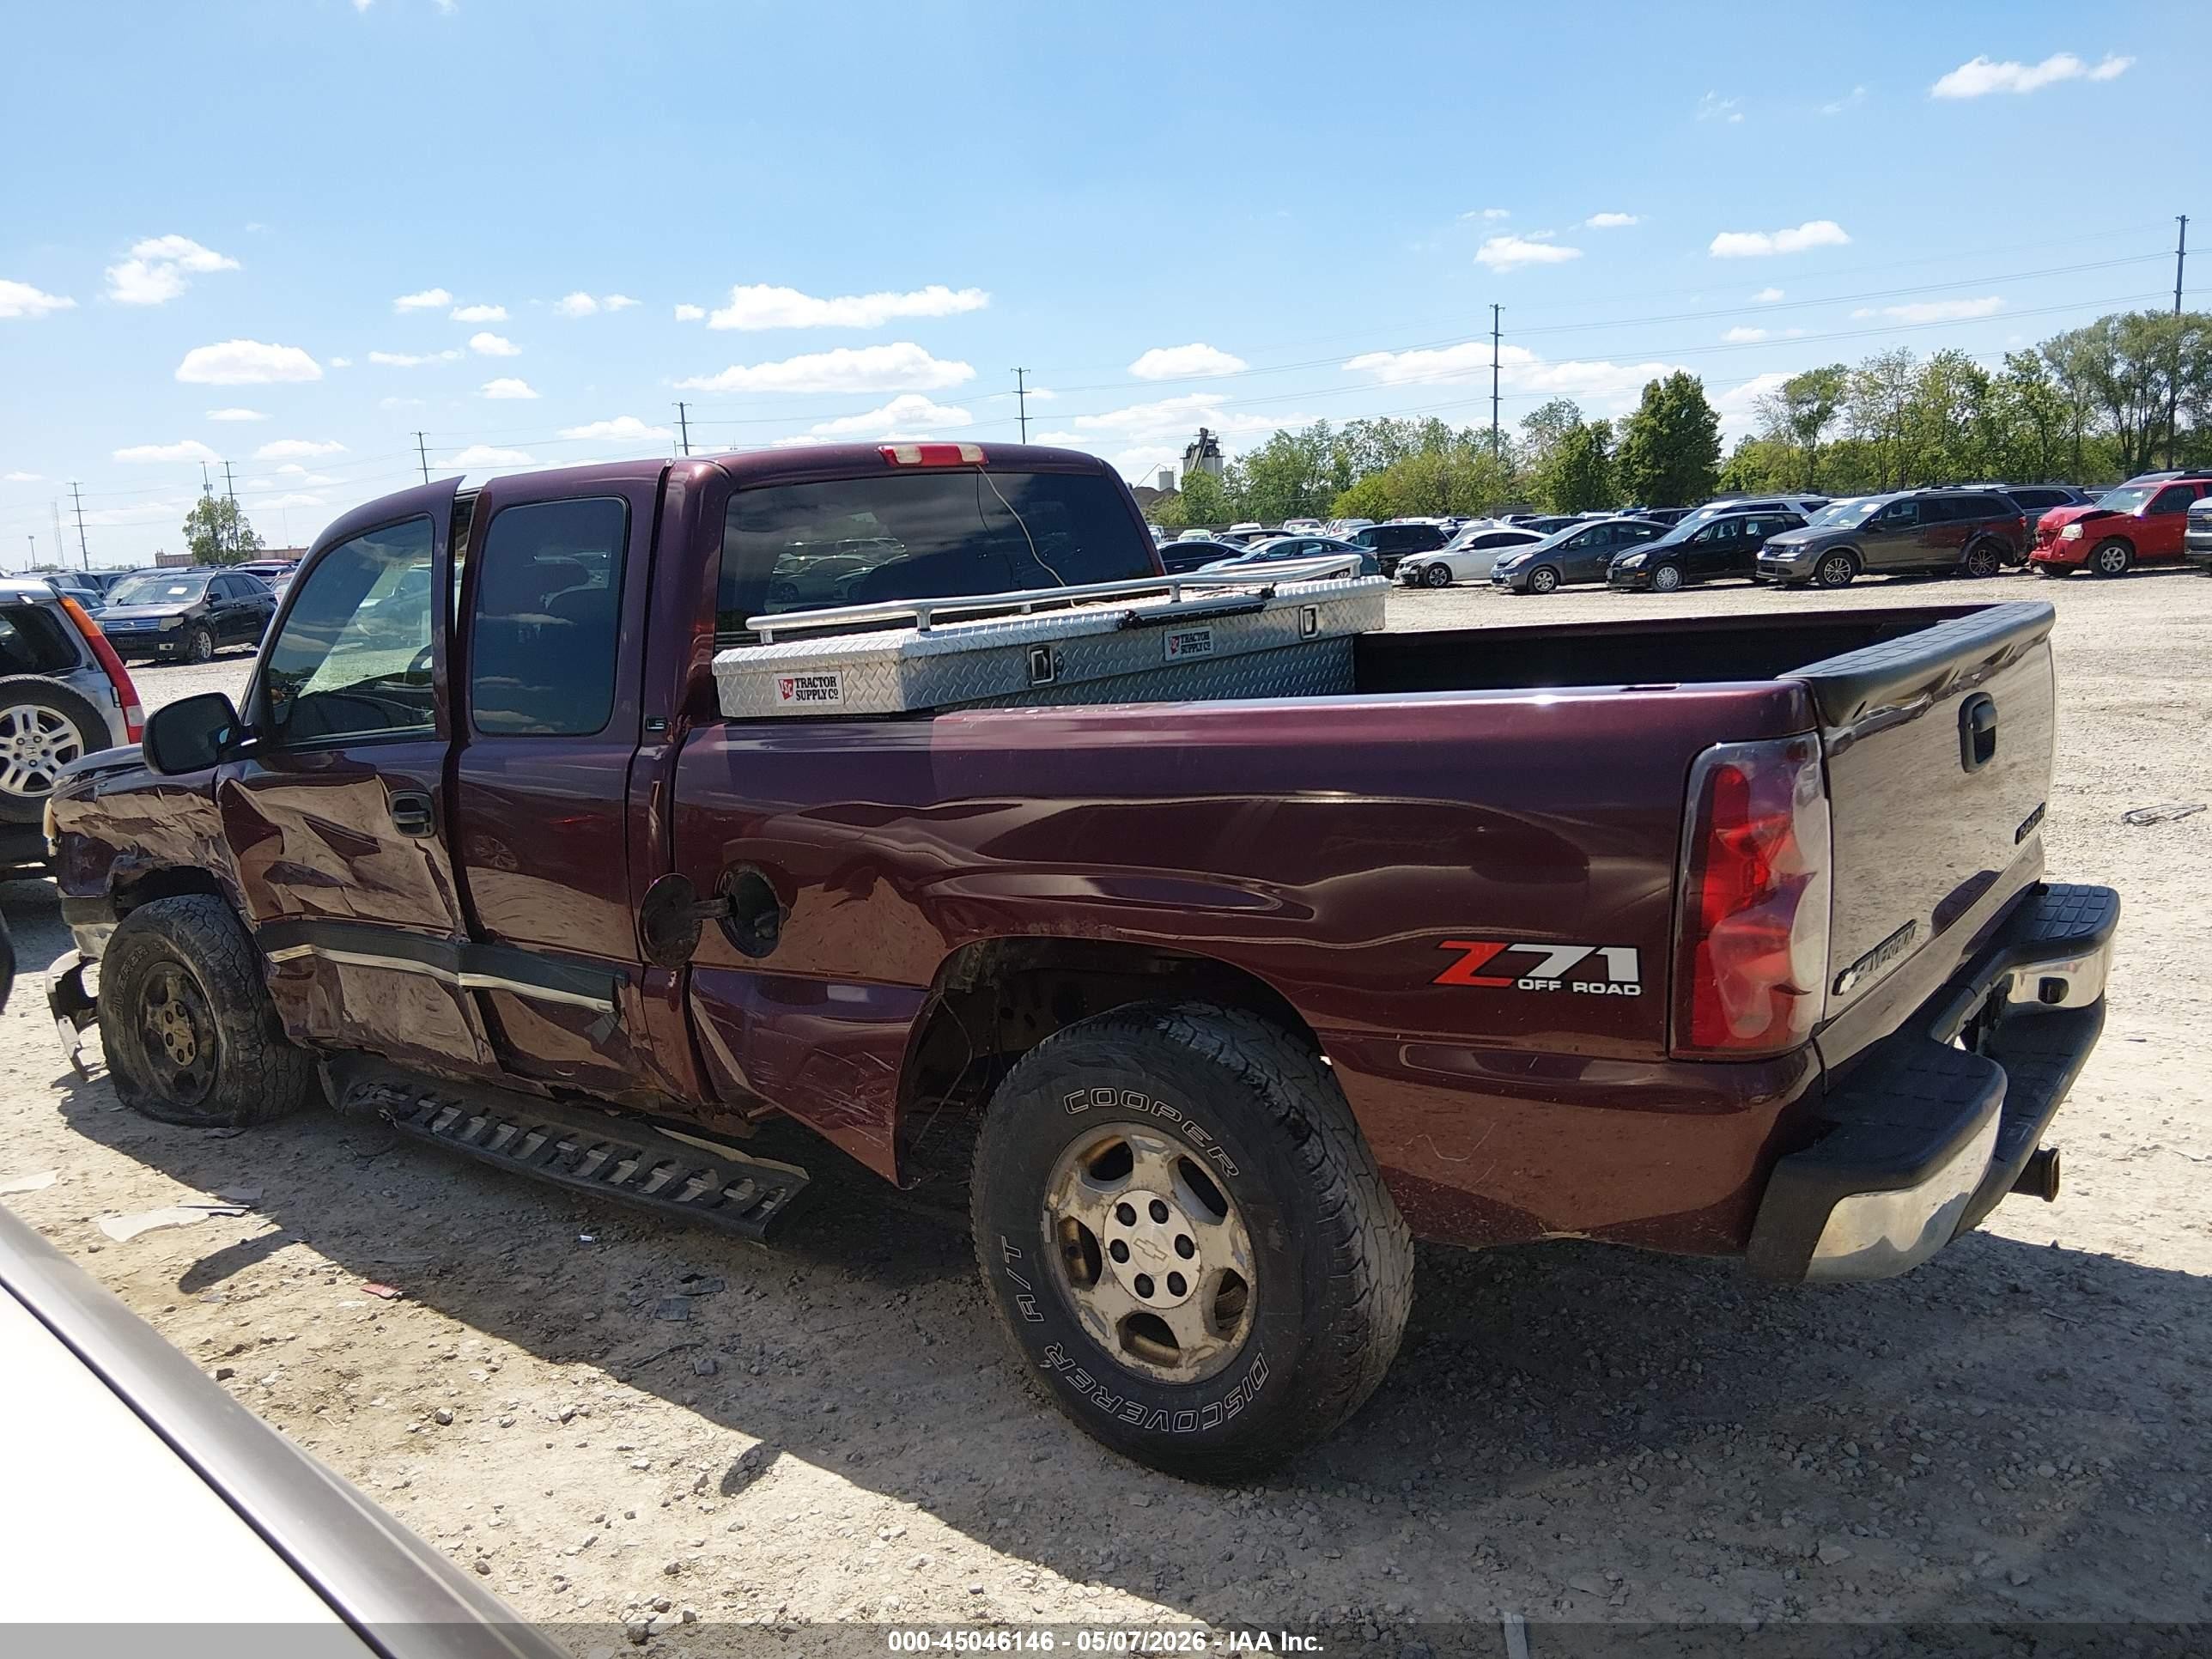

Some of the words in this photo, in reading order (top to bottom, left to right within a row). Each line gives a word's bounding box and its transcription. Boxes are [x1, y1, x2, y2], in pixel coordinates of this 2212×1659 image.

[1180, 631, 1210, 643] TRACTOR
[795, 676, 837, 689] TRACTOR
[796, 689, 827, 701] SUPPLY
[647, 720, 665, 729] LS
[1431, 939, 1639, 988] Z71
[1517, 978, 1562, 991] OFF
[1572, 981, 1642, 996] ROAD
[1063, 1087, 1240, 1178] COOPER
[1001, 1235, 1045, 1322] A/T
[1044, 1341, 1270, 1433] DISCOVERER
